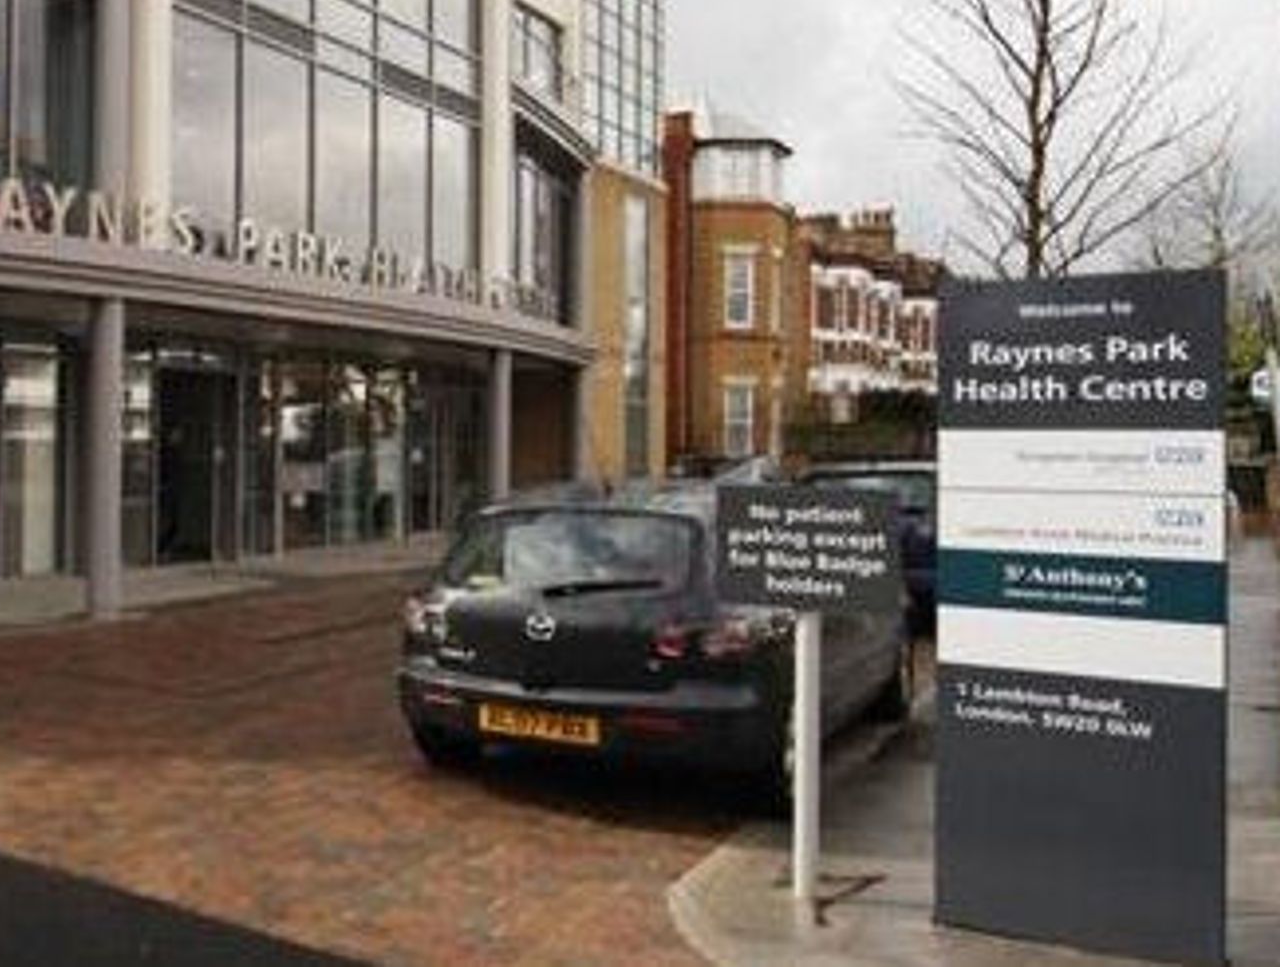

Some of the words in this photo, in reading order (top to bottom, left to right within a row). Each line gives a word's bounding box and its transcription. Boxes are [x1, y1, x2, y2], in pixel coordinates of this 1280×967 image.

[239, 216, 351, 284] PARK
[970, 339, 1094, 372] Raynes
[1106, 333, 1189, 362] Park
[953, 375, 1067, 402] Health
[1079, 375, 1207, 401] Centre
[747, 504, 780, 520] No
[784, 507, 863, 526] patient
[727, 526, 809, 550] parking
[813, 533, 887, 553] except
[728, 548, 760, 567] for
[765, 550, 812, 570] Blue
[816, 552, 887, 577] Badge
[766, 573, 846, 596] holders
[1025, 565, 1148, 593] Anthony's
